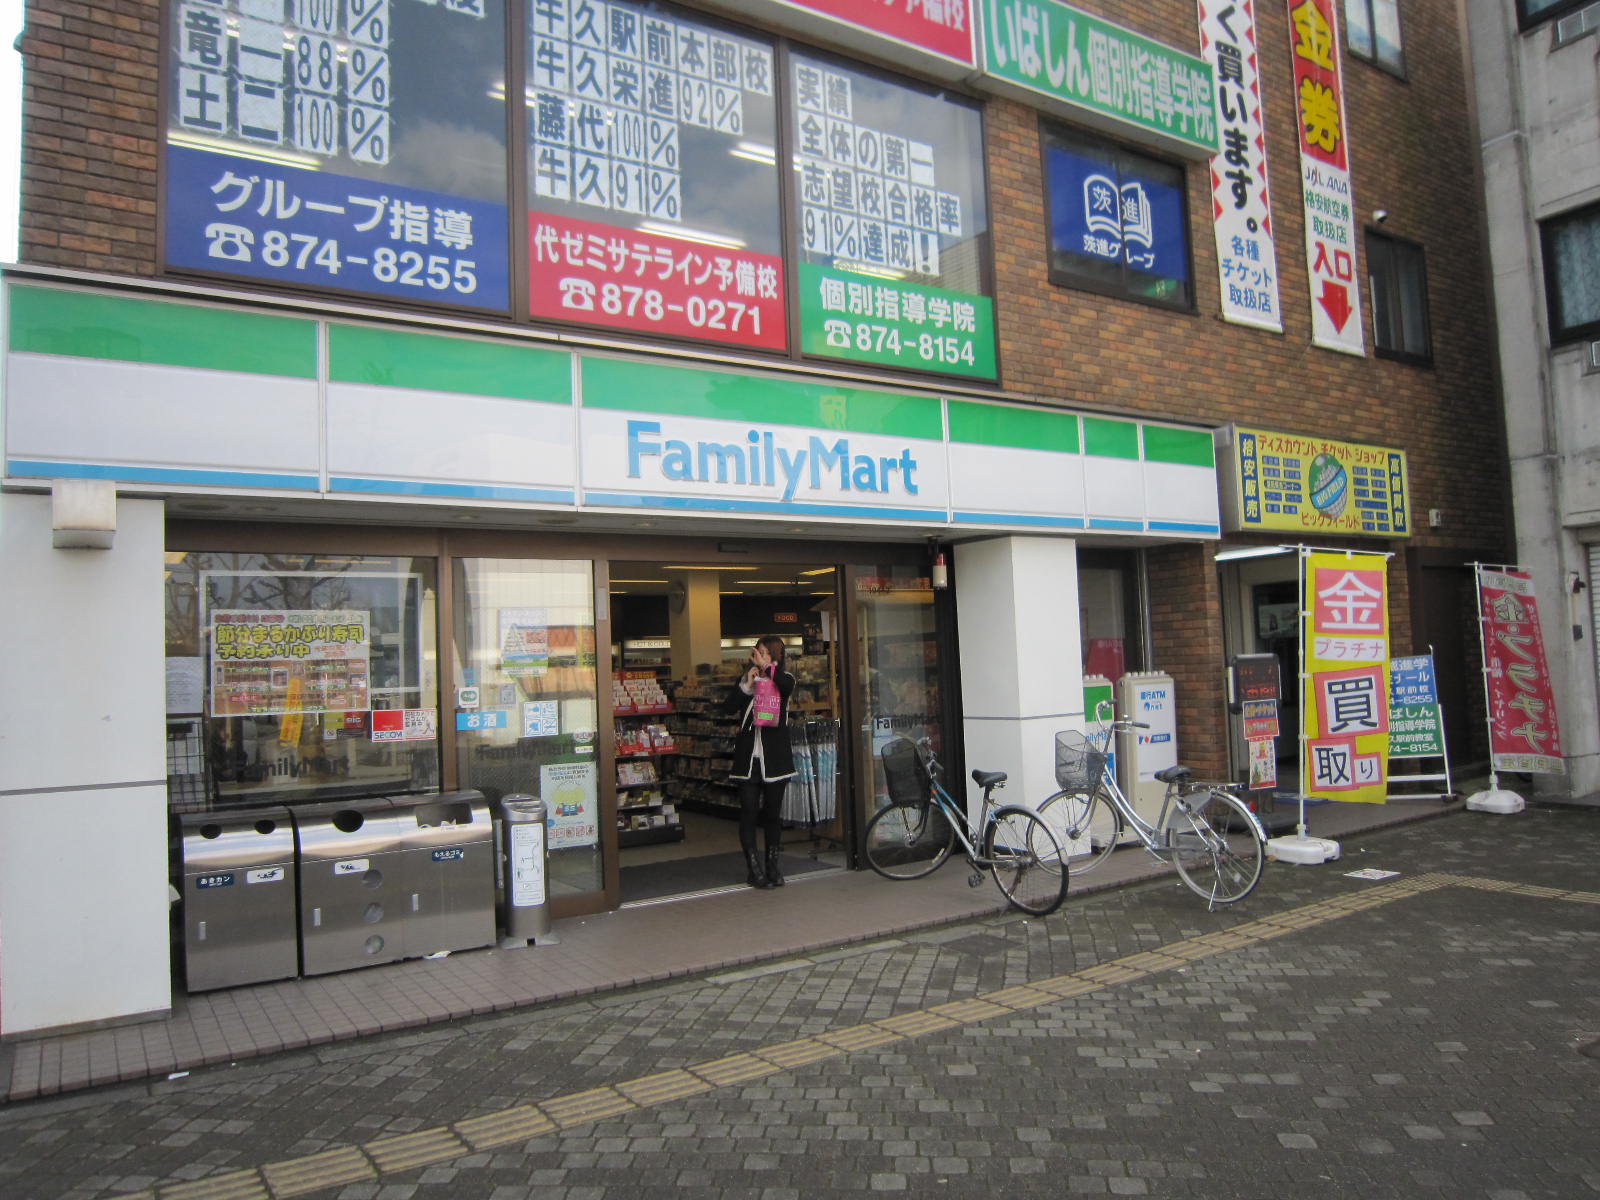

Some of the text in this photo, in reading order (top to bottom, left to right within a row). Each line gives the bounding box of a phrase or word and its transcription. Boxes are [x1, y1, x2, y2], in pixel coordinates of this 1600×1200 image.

[536, 0, 769, 93] 牛久駅前本部校
[1292, 0, 1341, 153] 金券
[536, 40, 741, 132] 牛久栄進92%
[537, 92, 676, 167] 藤代100%
[800, 113, 933, 177] 全体の第一
[210, 170, 475, 251] グループ指導
[537, 148, 678, 219] 牛久91%
[802, 161, 960, 233] 志望校合格率
[1231, 233, 1260, 262] 各種
[1312, 215, 1347, 244] 取扱店
[262, 229, 478, 294] 874-8255
[534, 223, 778, 300] 代ゼミサテライン予備校
[1221, 257, 1273, 289] チケット
[1312, 241, 1353, 282] 入口
[600, 283, 762, 336] 878-0271
[819, 276, 976, 333] 個別指導学院
[1228, 283, 1272, 313] 取扱店
[854, 324, 976, 367] 874-8154
[626, 419, 919, 503] FamilyMart
[1318, 571, 1382, 630] 金
[1316, 638, 1384, 659] プラチナ
[1327, 677, 1378, 732] 買
